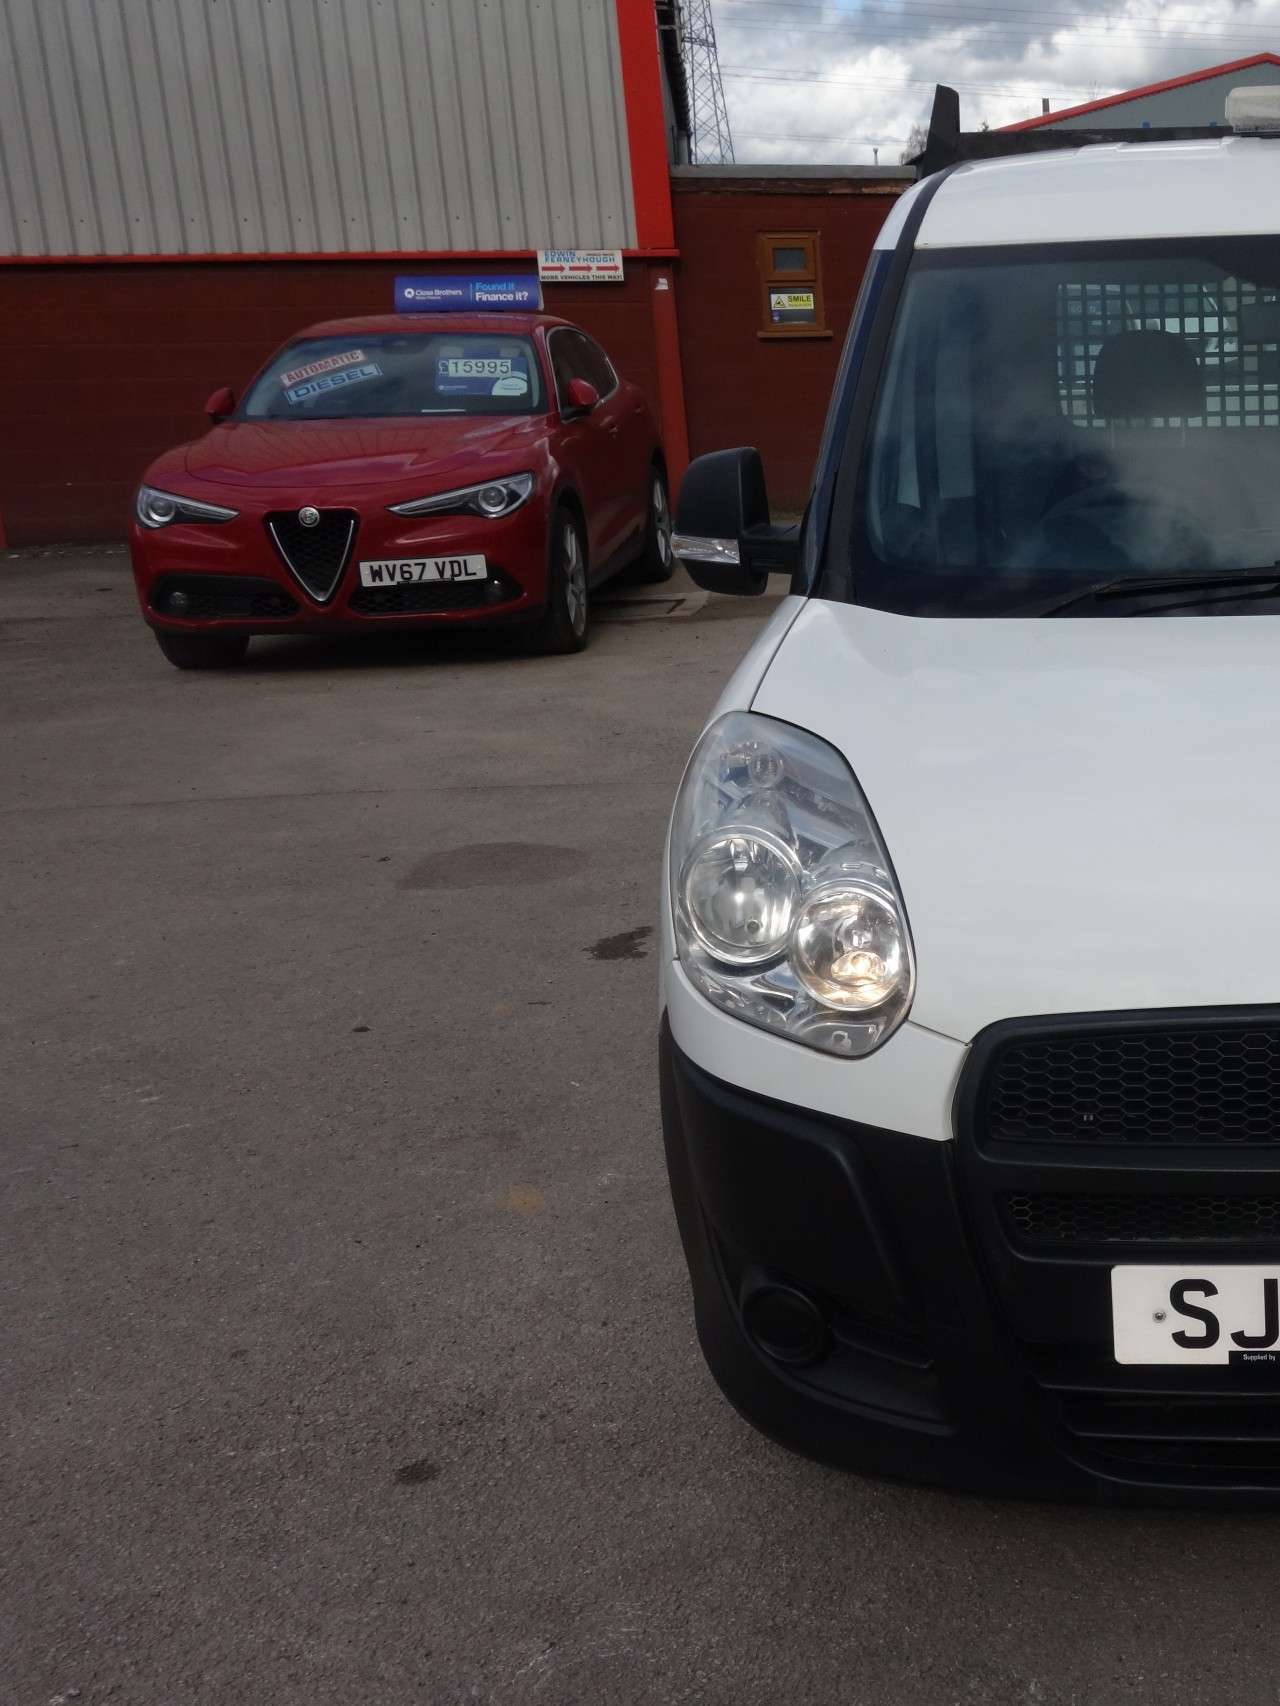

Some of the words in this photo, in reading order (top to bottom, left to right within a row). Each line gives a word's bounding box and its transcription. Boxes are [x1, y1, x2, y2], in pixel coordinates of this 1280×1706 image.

[544, 249, 576, 257] EDWIN
[434, 288, 463, 296] Brothers
[475, 292, 514, 301] Finance
[515, 291, 529, 301] it?
[286, 351, 360, 382] AUTOMATIC
[293, 368, 374, 398] DIESEL
[369, 562, 426, 583] WV67
[434, 559, 477, 579] VDL
[1243, 1353, 1268, 1362] Supplied
[1269, 1353, 1276, 1362] by
